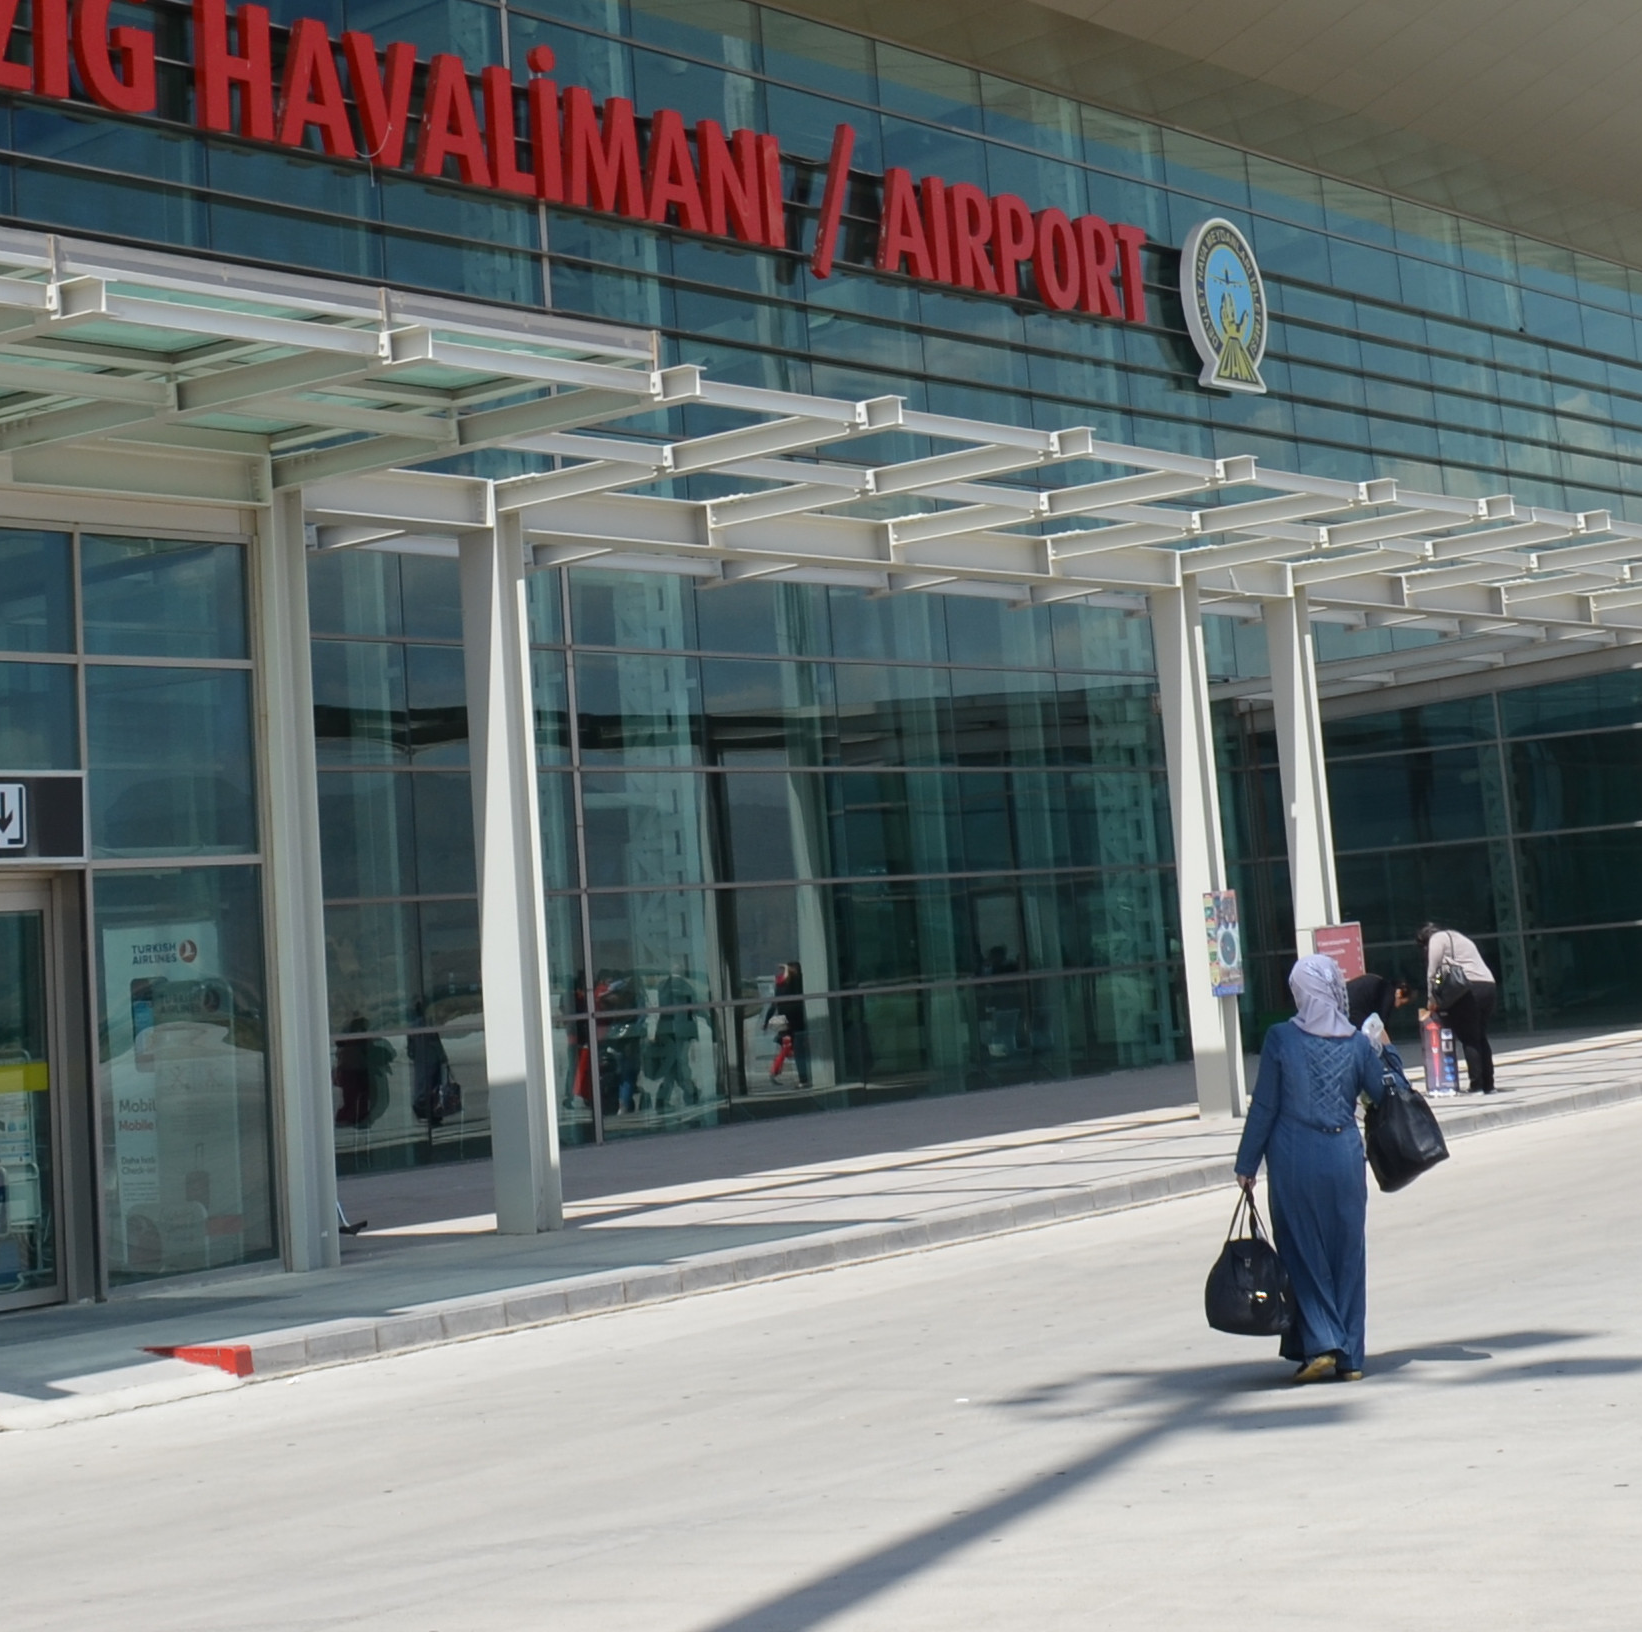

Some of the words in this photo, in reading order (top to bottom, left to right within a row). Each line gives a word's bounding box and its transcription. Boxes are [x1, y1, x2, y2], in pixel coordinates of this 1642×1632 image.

[811, 123, 856, 280] /
[876, 167, 1147, 323] AIRPORT
[131, 942, 177, 955] TURKISH
[132, 953, 177, 965] AIRLINES
